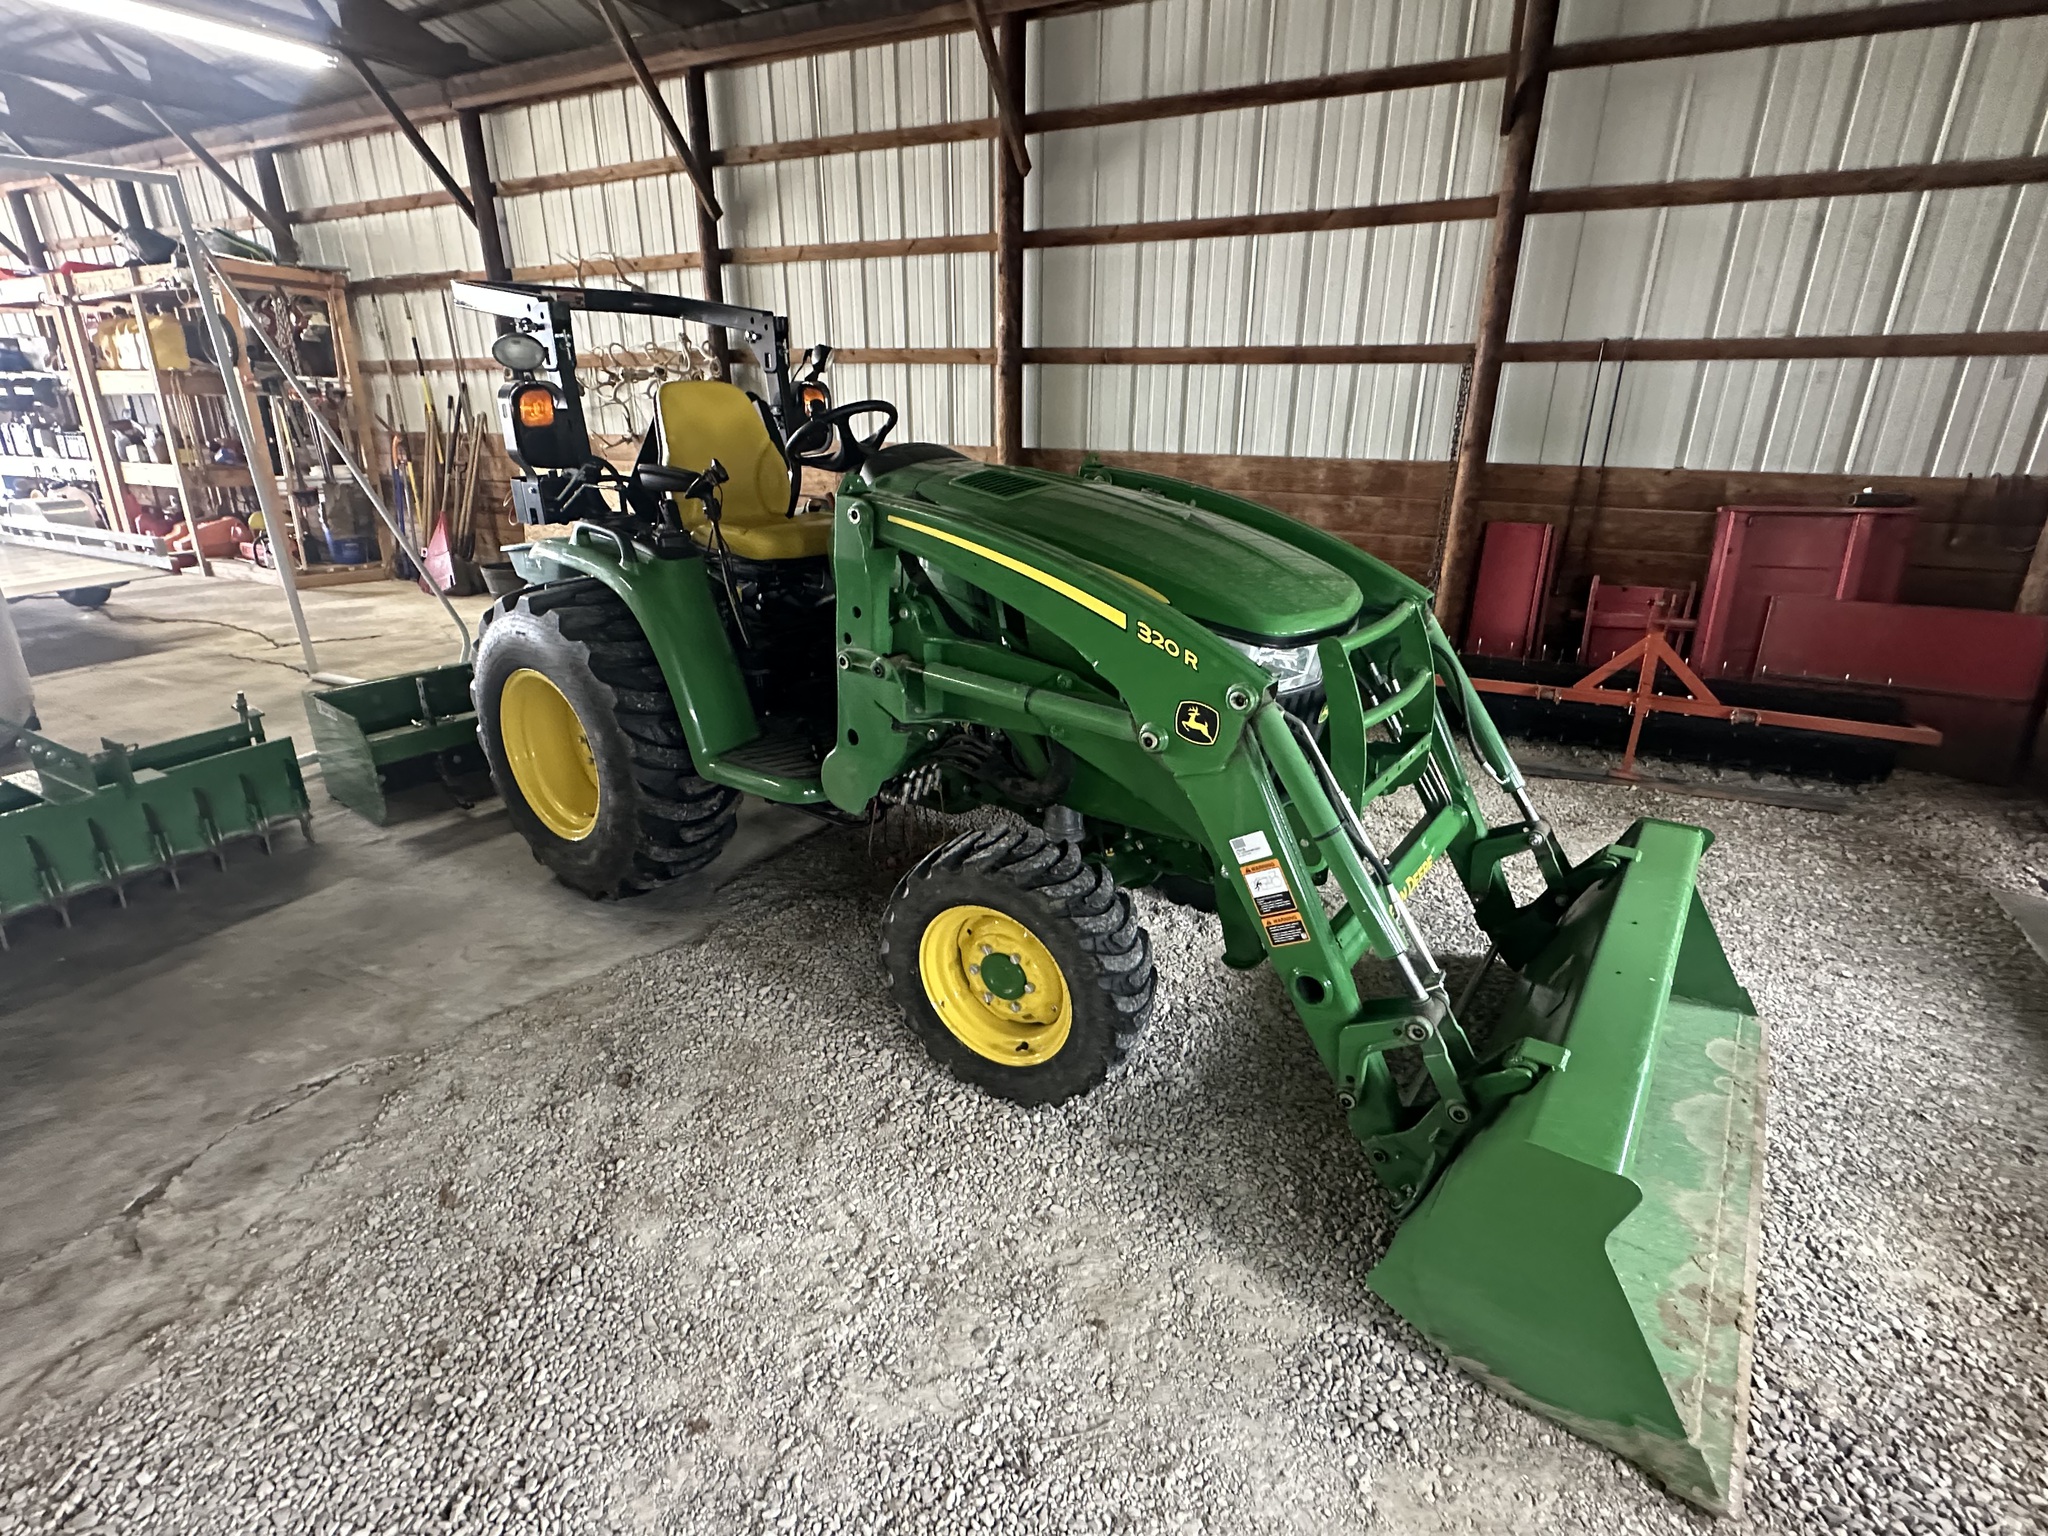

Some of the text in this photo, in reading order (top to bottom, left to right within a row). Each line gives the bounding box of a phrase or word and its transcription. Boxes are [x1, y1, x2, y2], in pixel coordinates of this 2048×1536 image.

[1136, 620, 1199, 671] 320 R
[1250, 861, 1276, 871] WARNING
[1405, 854, 1433, 896] DEERE
[1273, 915, 1298, 924] WARNING
